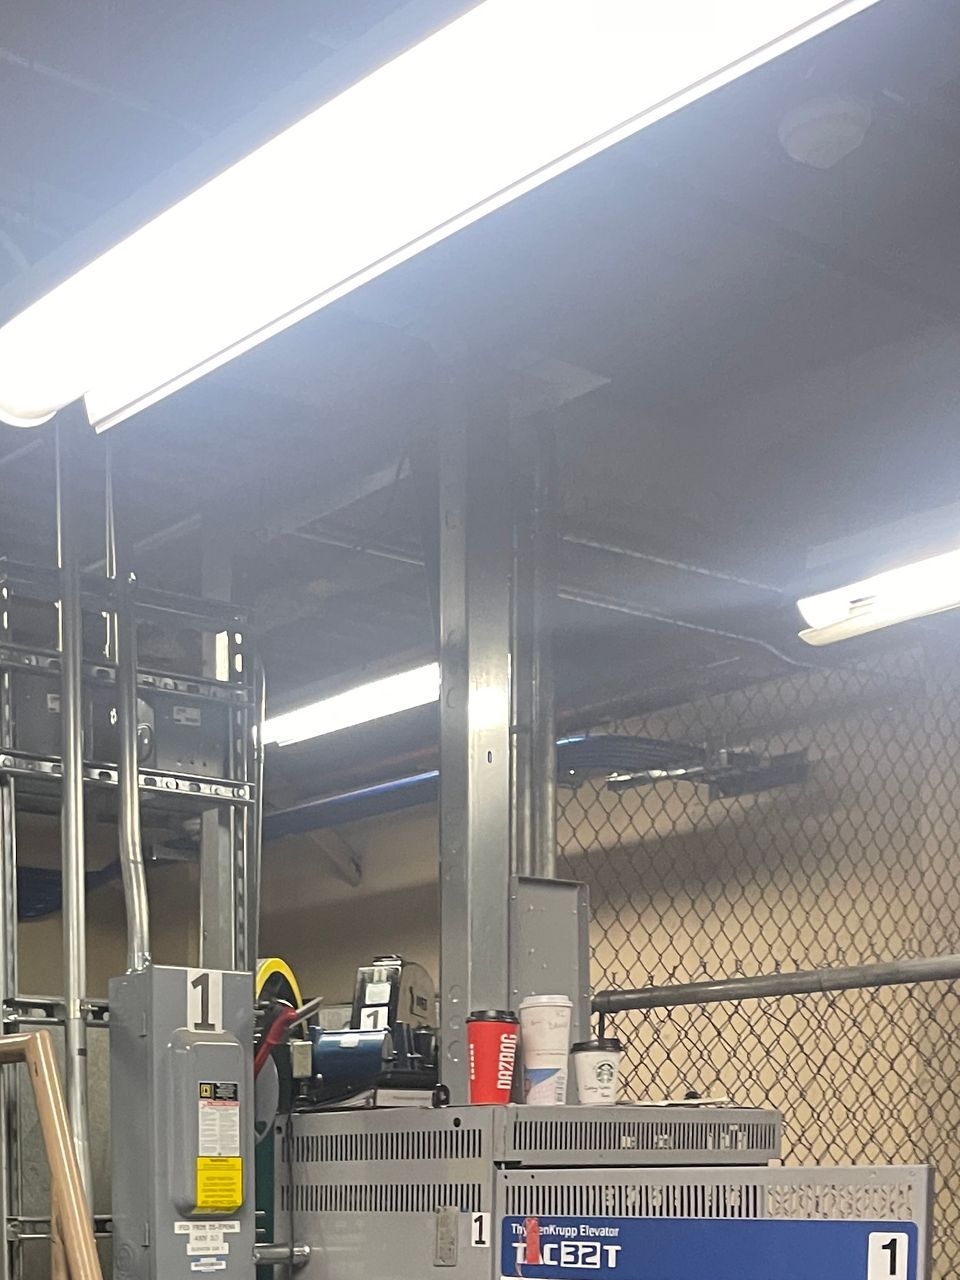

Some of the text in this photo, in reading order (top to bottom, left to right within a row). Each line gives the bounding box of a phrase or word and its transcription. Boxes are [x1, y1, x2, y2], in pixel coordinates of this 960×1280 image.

[191, 972, 216, 1031] 1
[366, 1009, 379, 1030] 1
[473, 1214, 486, 1245] 1
[511, 1223, 620, 1239] ThyenKrupp Elevator
[511, 1242, 622, 1268] TC32T
[881, 1238, 897, 1276] 1
